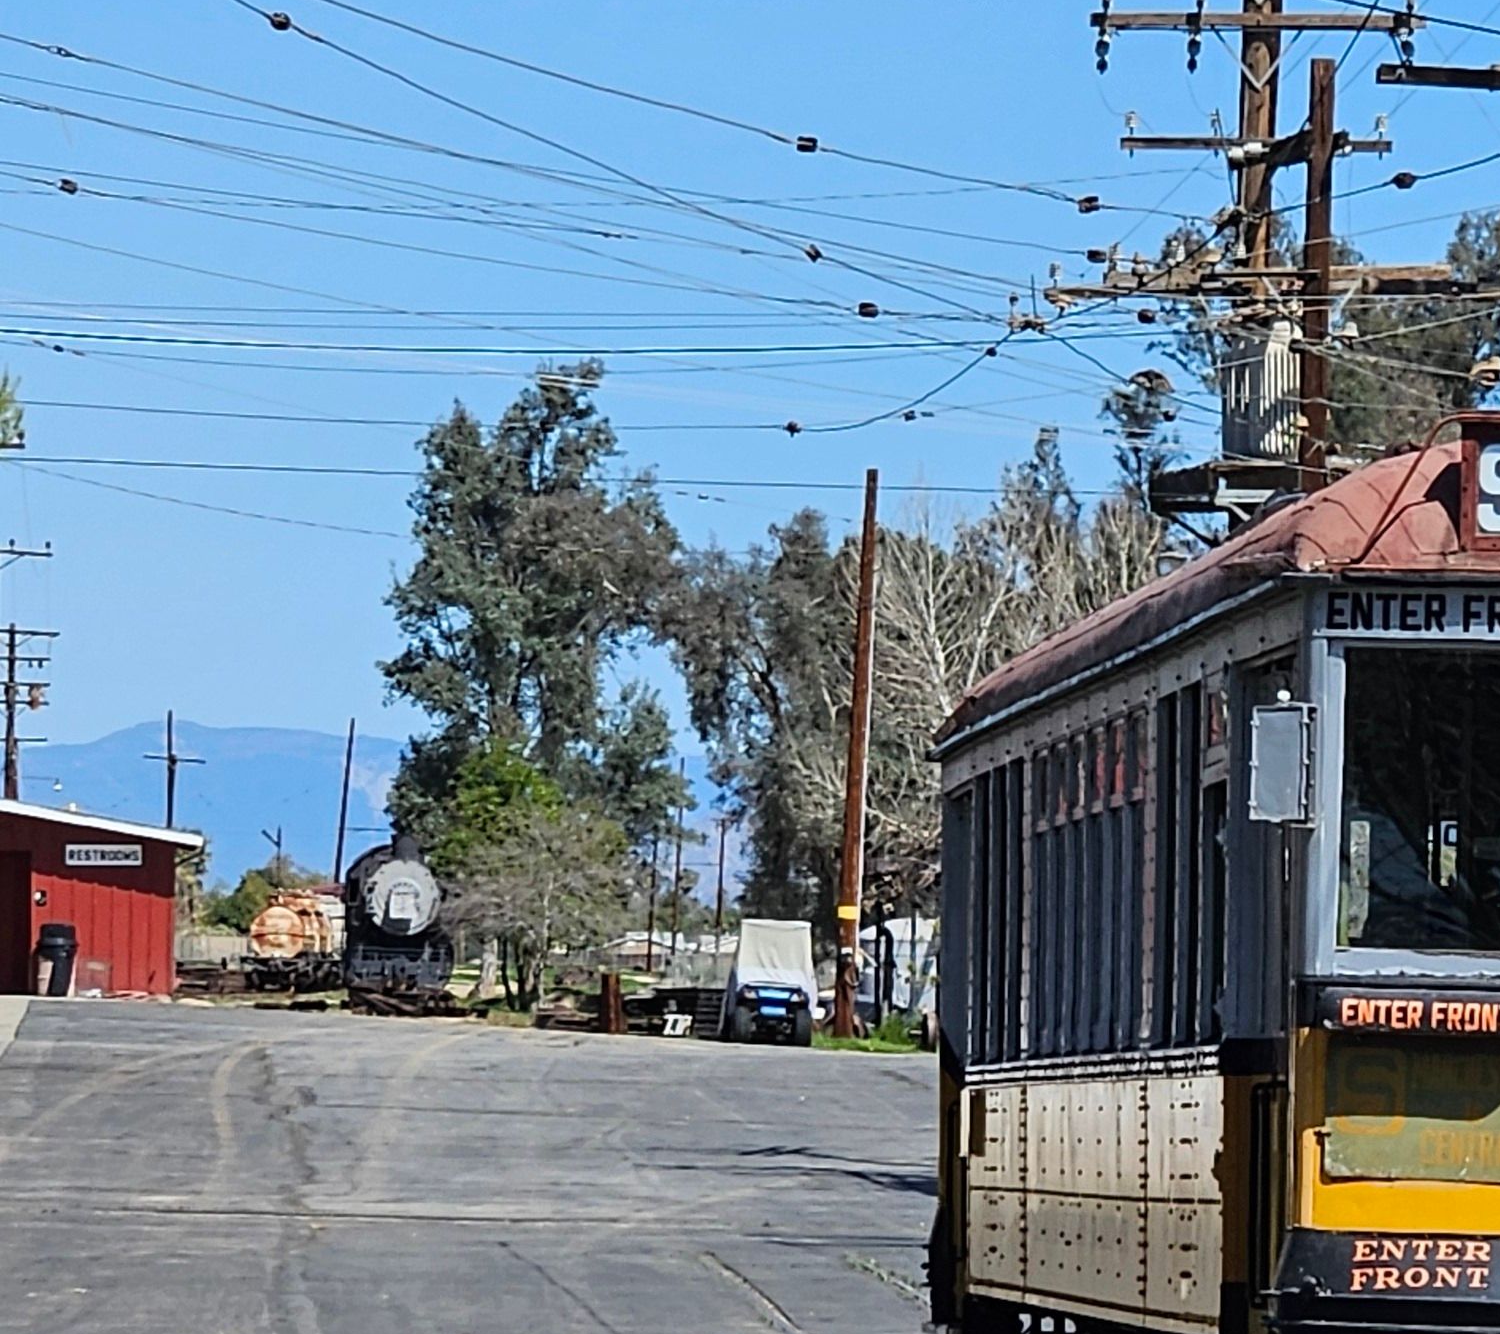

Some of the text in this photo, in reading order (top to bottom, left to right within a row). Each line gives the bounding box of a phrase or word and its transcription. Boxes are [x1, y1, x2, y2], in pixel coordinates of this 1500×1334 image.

[1325, 591, 1447, 633] ENTER
[68, 849, 140, 861] RESTROOMS
[1340, 997, 1424, 1029] ENTER
[1352, 1239, 1491, 1262] ENTER
[1350, 1266, 1490, 1292] FRONT
